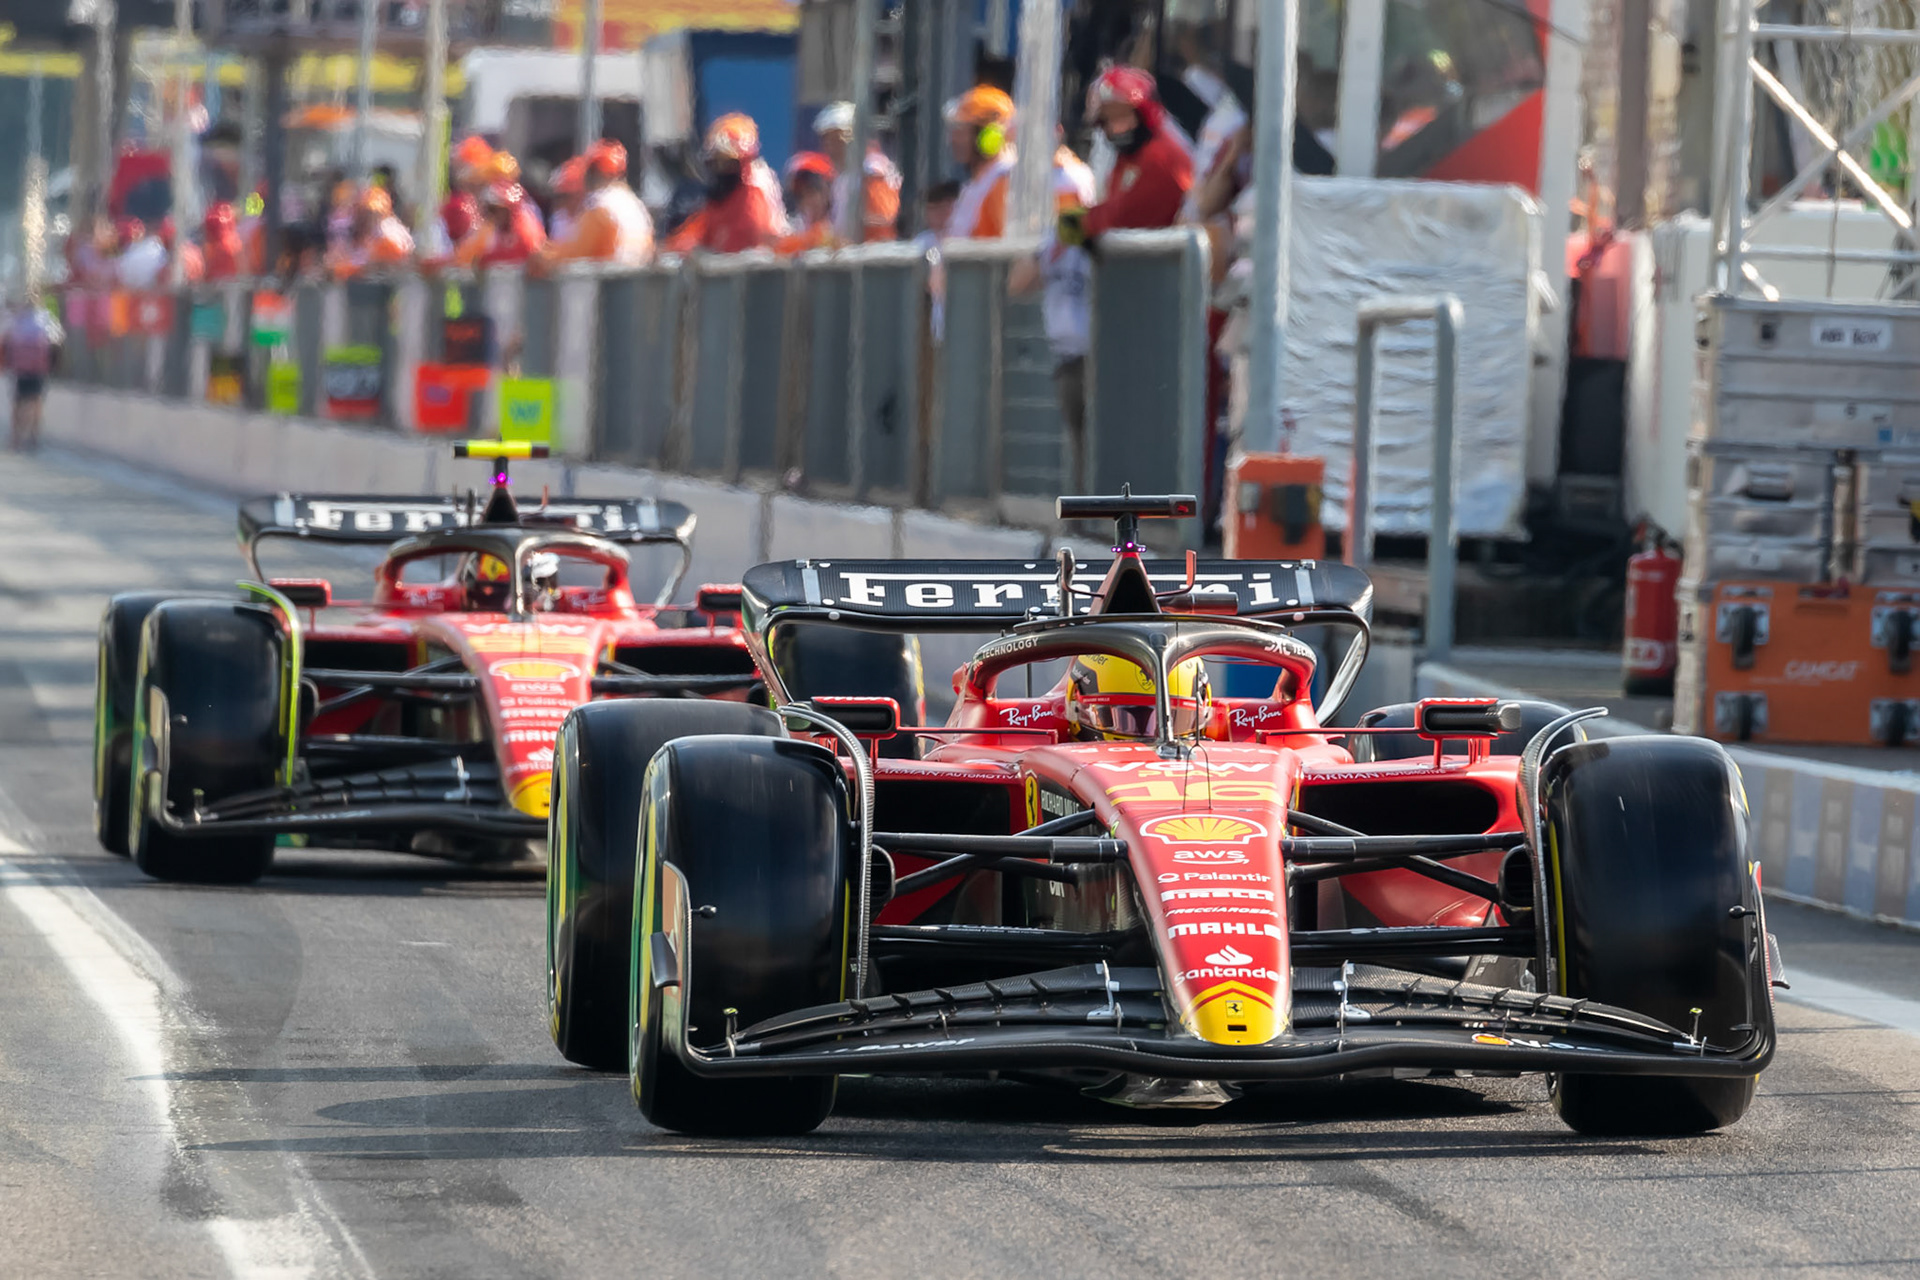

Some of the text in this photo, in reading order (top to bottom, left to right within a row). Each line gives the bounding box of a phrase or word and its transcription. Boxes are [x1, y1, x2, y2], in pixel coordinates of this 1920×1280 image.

[308, 501, 624, 532] Ferri
[839, 572, 1280, 607] Ferri
[982, 637, 1039, 660] TECHNOLOGY
[1229, 705, 1282, 727] Ray-Ban
[1138, 769, 1235, 778] PLAY
[1173, 850, 1247, 860] aws
[1183, 872, 1272, 882] Palantir
